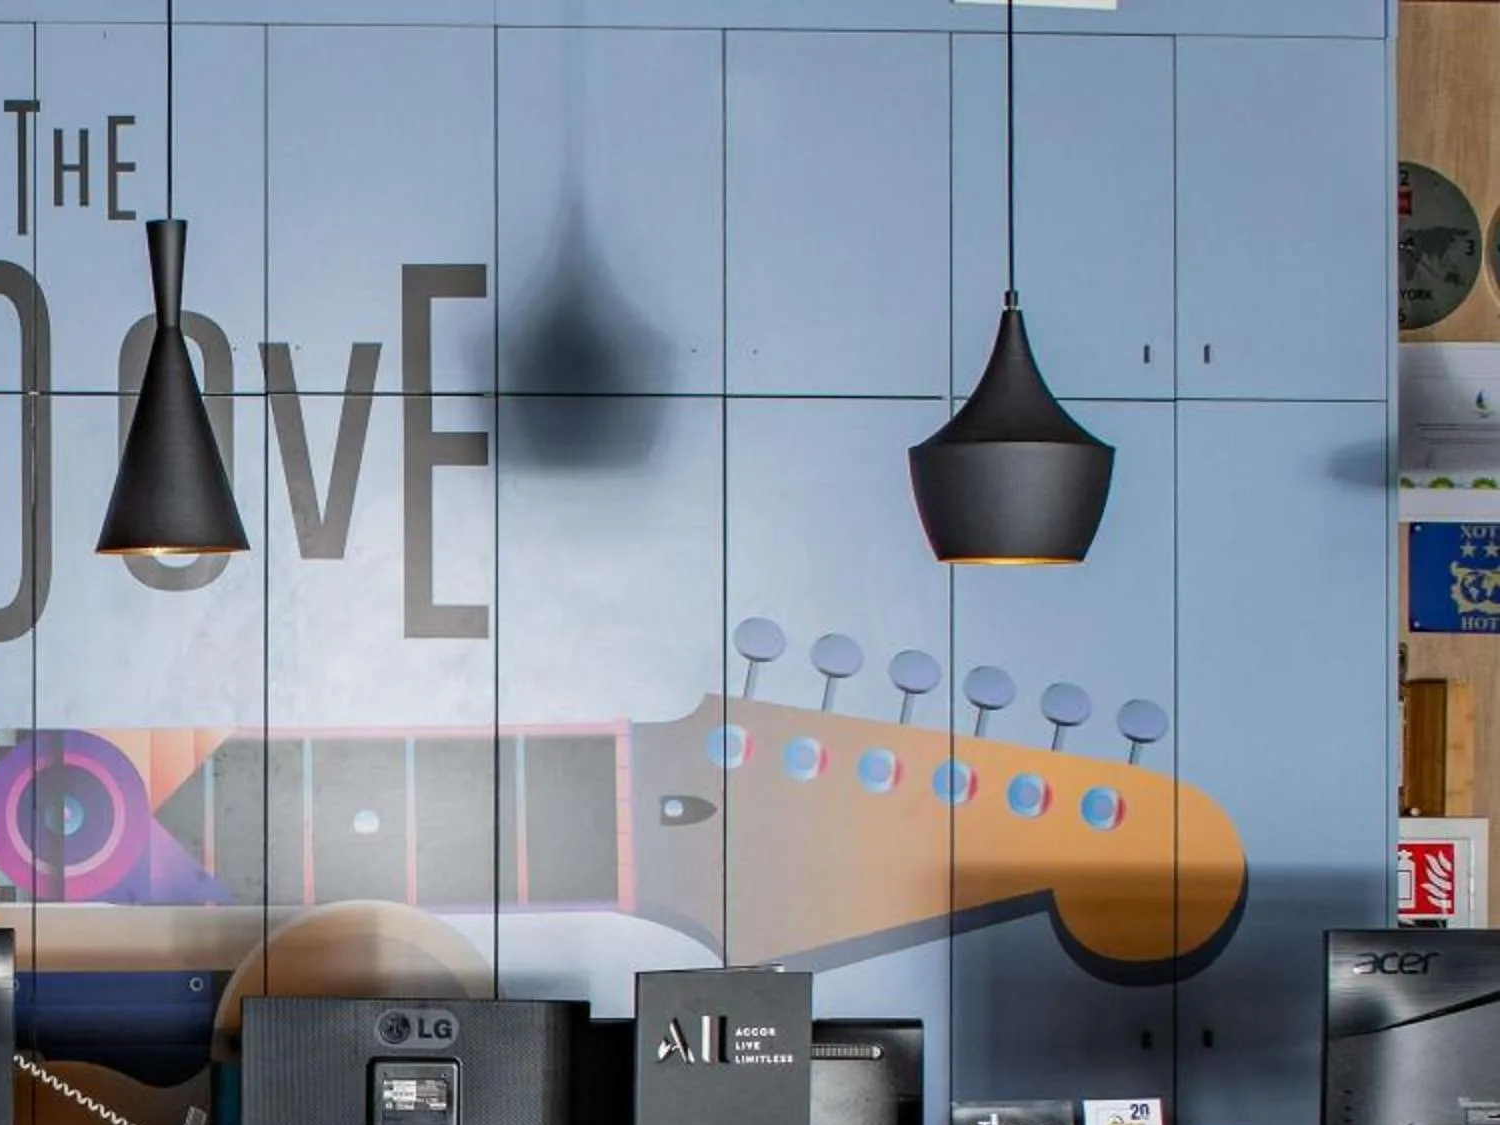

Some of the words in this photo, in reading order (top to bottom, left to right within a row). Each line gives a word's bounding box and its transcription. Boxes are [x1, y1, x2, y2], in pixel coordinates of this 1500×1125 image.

[4, 99, 137, 235] THE
[1461, 616, 1500, 631] HOT
[1353, 952, 1444, 975] acer
[418, 1018, 454, 1040] LG
[735, 1027, 777, 1037] ACCOR
[735, 1041, 762, 1051] LIVE
[735, 1054, 794, 1064] LIMITLESS
